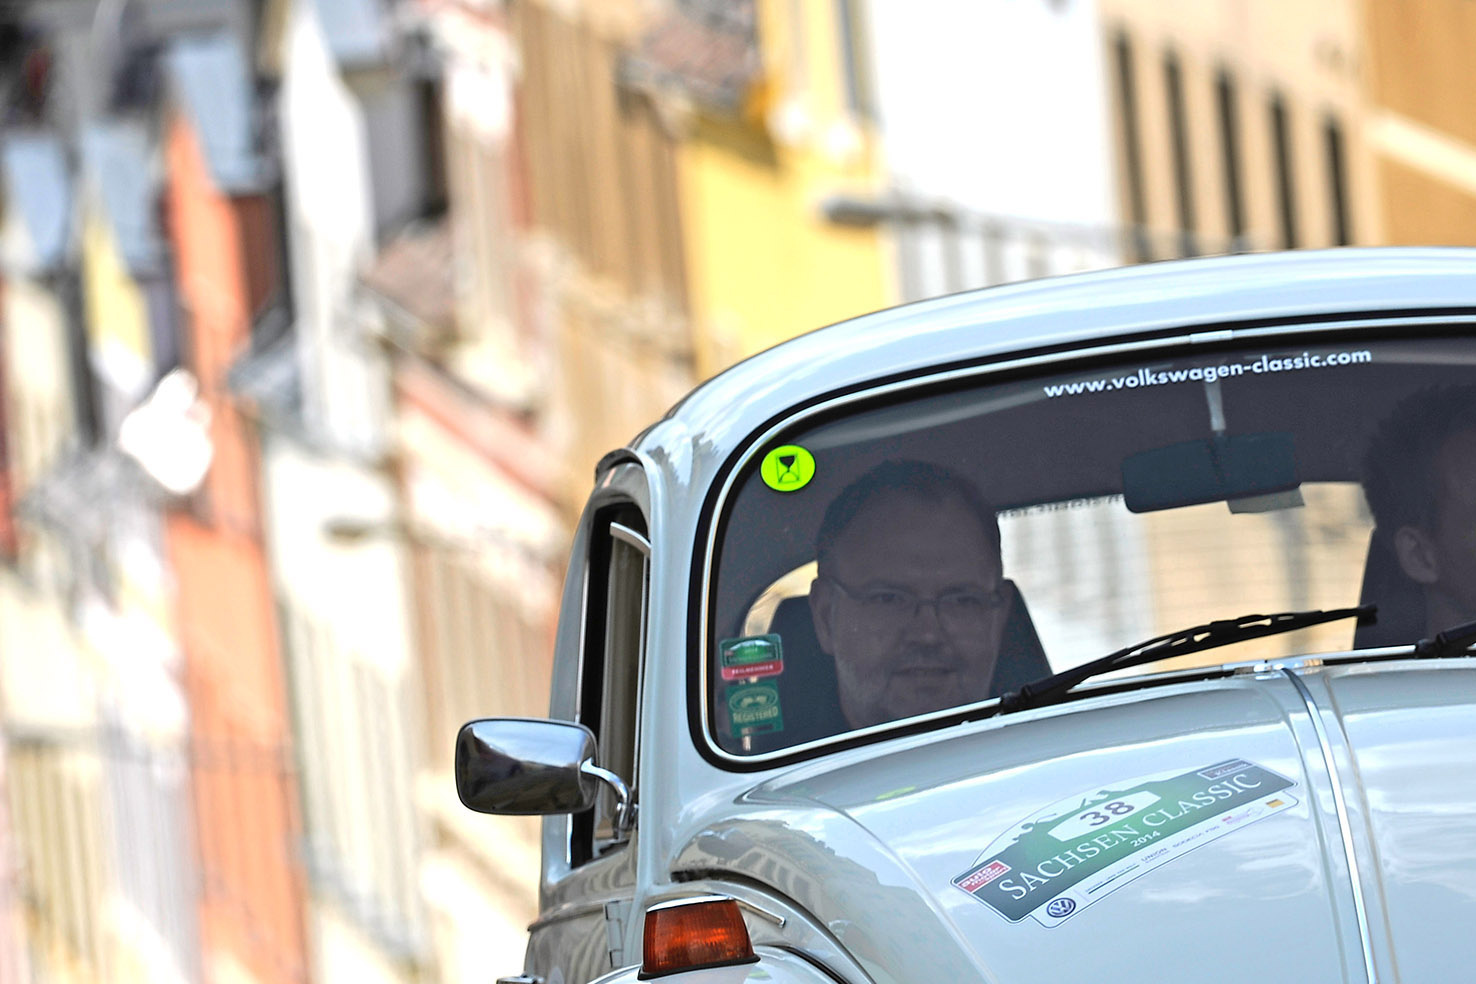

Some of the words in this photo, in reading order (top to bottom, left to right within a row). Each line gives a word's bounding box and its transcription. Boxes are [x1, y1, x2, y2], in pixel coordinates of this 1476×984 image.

[1043, 349, 1372, 398] www.volkswagen-classic.com
[733, 706, 779, 724] REGISTERED
[1080, 800, 1135, 826] 38
[998, 823, 1140, 900] SACHSEN
[1142, 773, 1262, 828] CLASSIC
[1130, 830, 1161, 847] 2014
